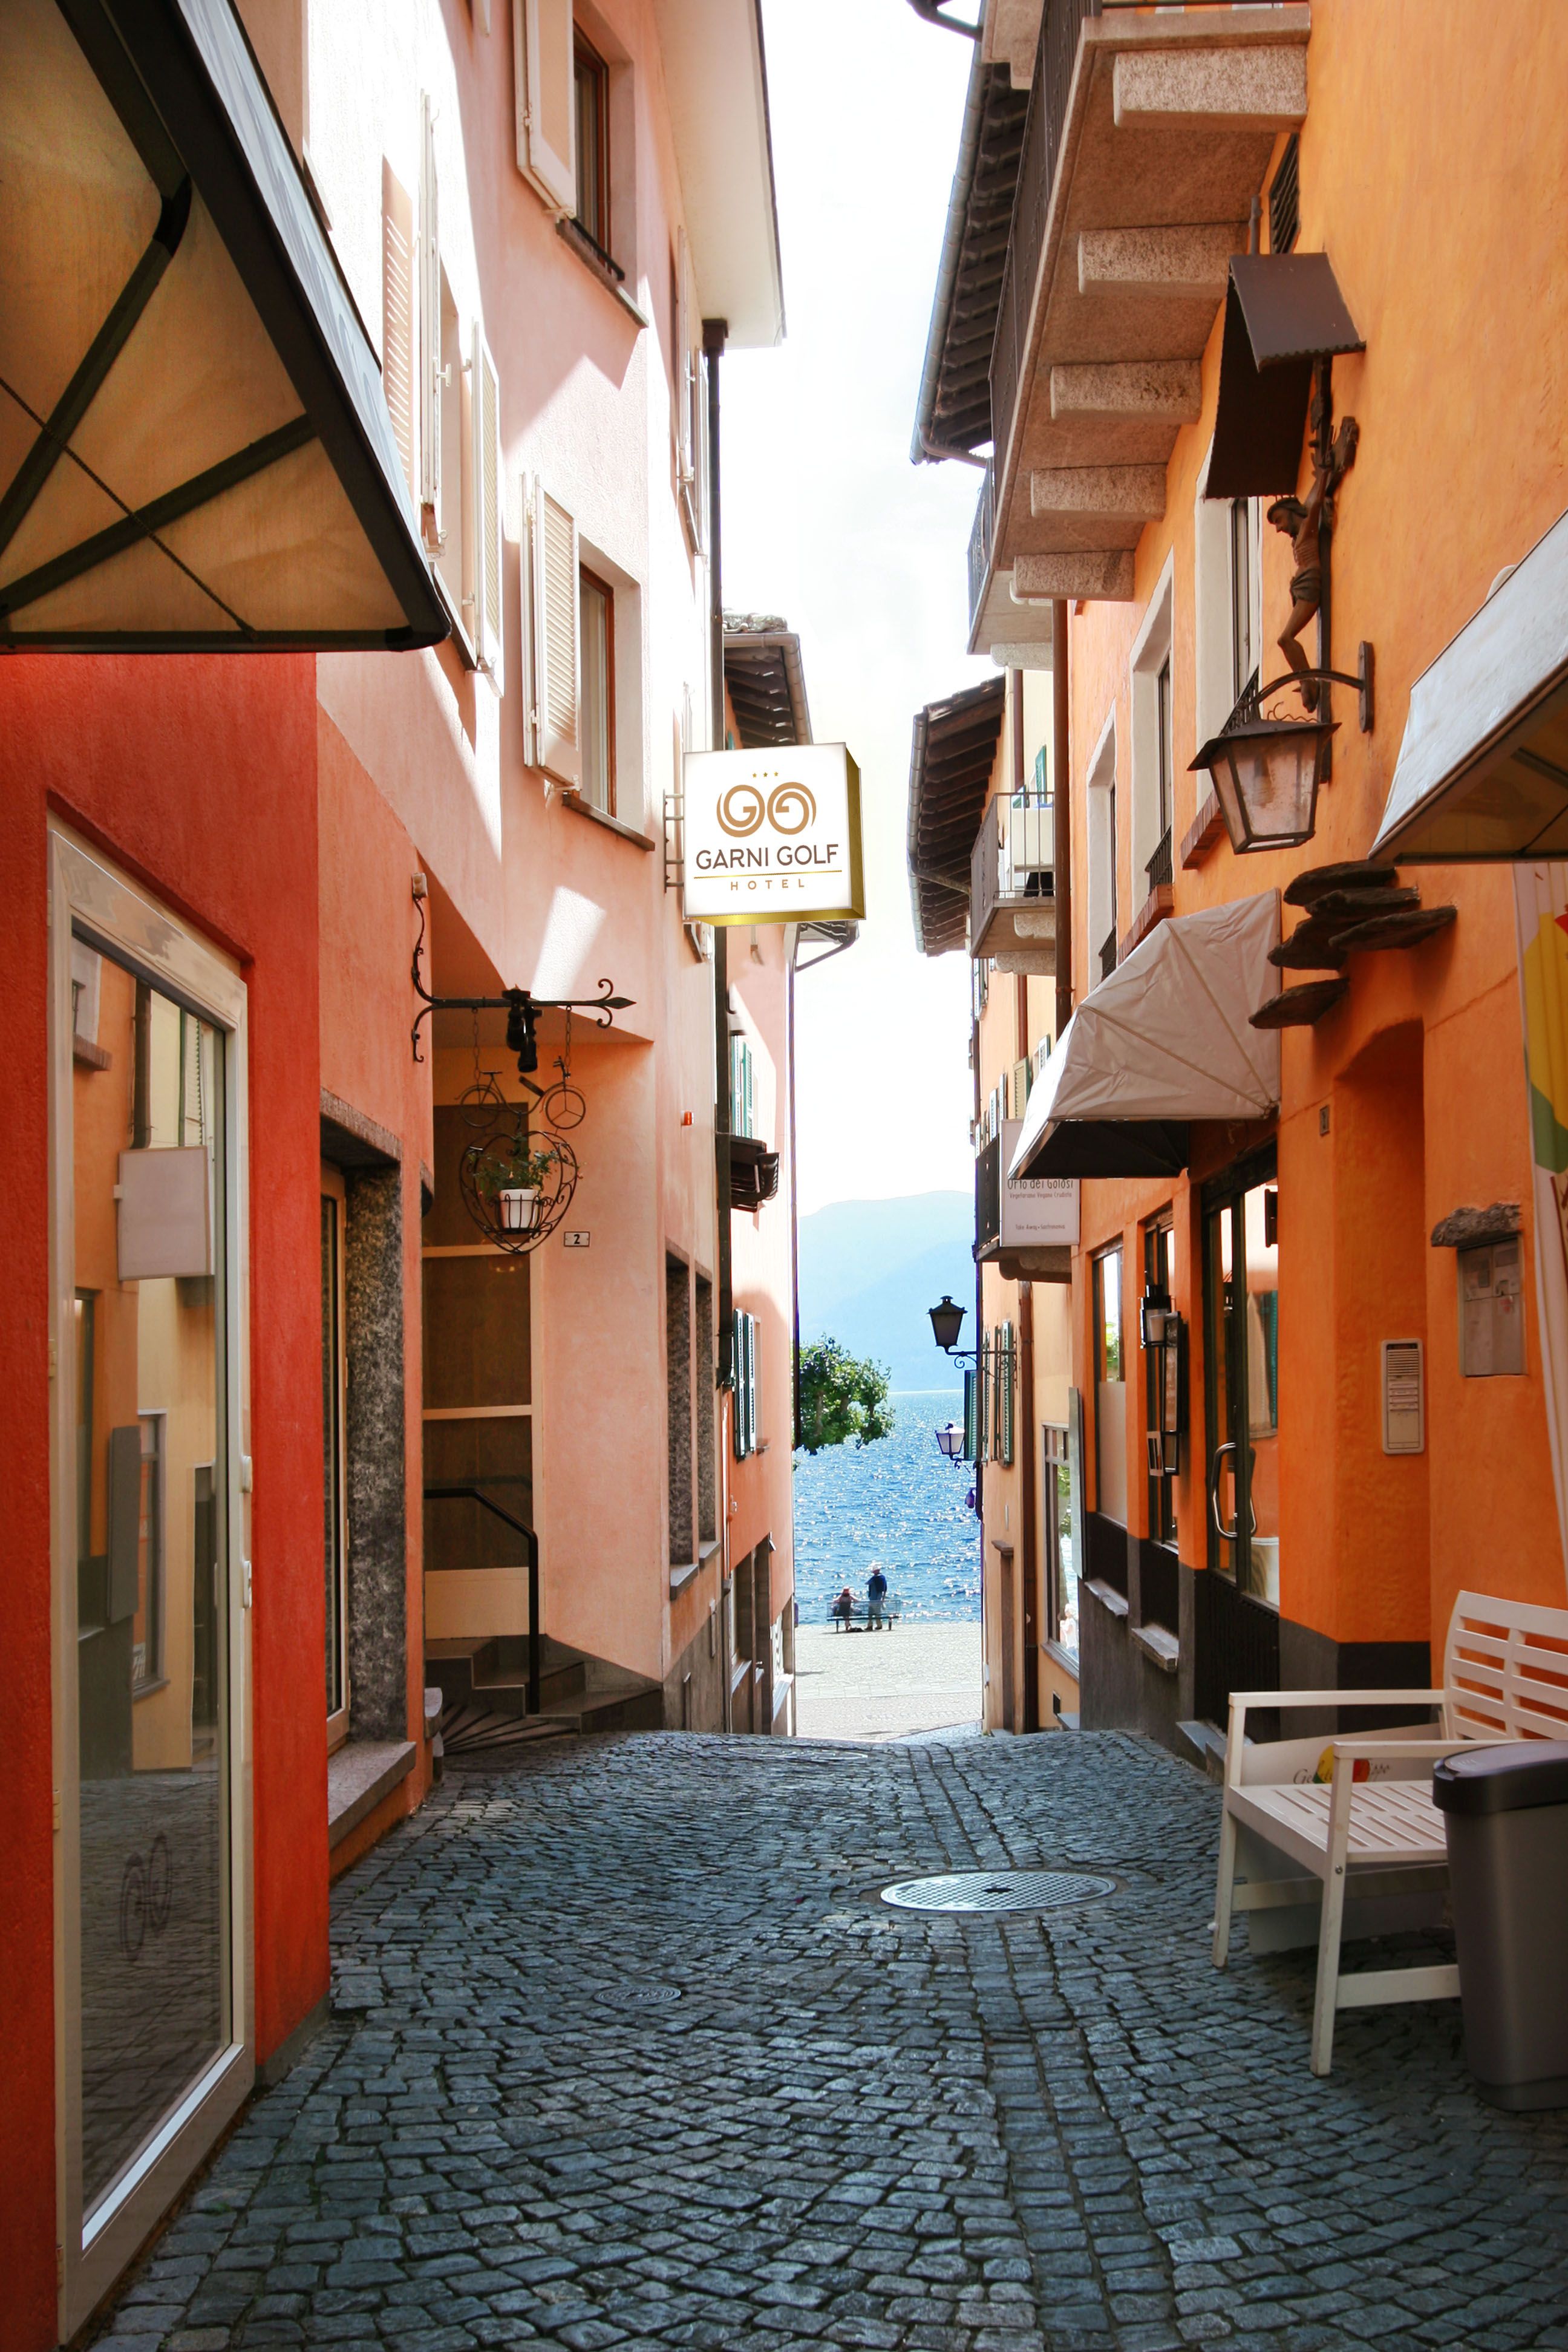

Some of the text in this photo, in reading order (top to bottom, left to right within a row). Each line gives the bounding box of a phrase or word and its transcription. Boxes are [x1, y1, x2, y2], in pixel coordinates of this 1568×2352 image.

[696, 844, 839, 870] GARNI GOLF
[731, 878, 805, 890] HOTEL
[573, 1233, 580, 1244] 2
